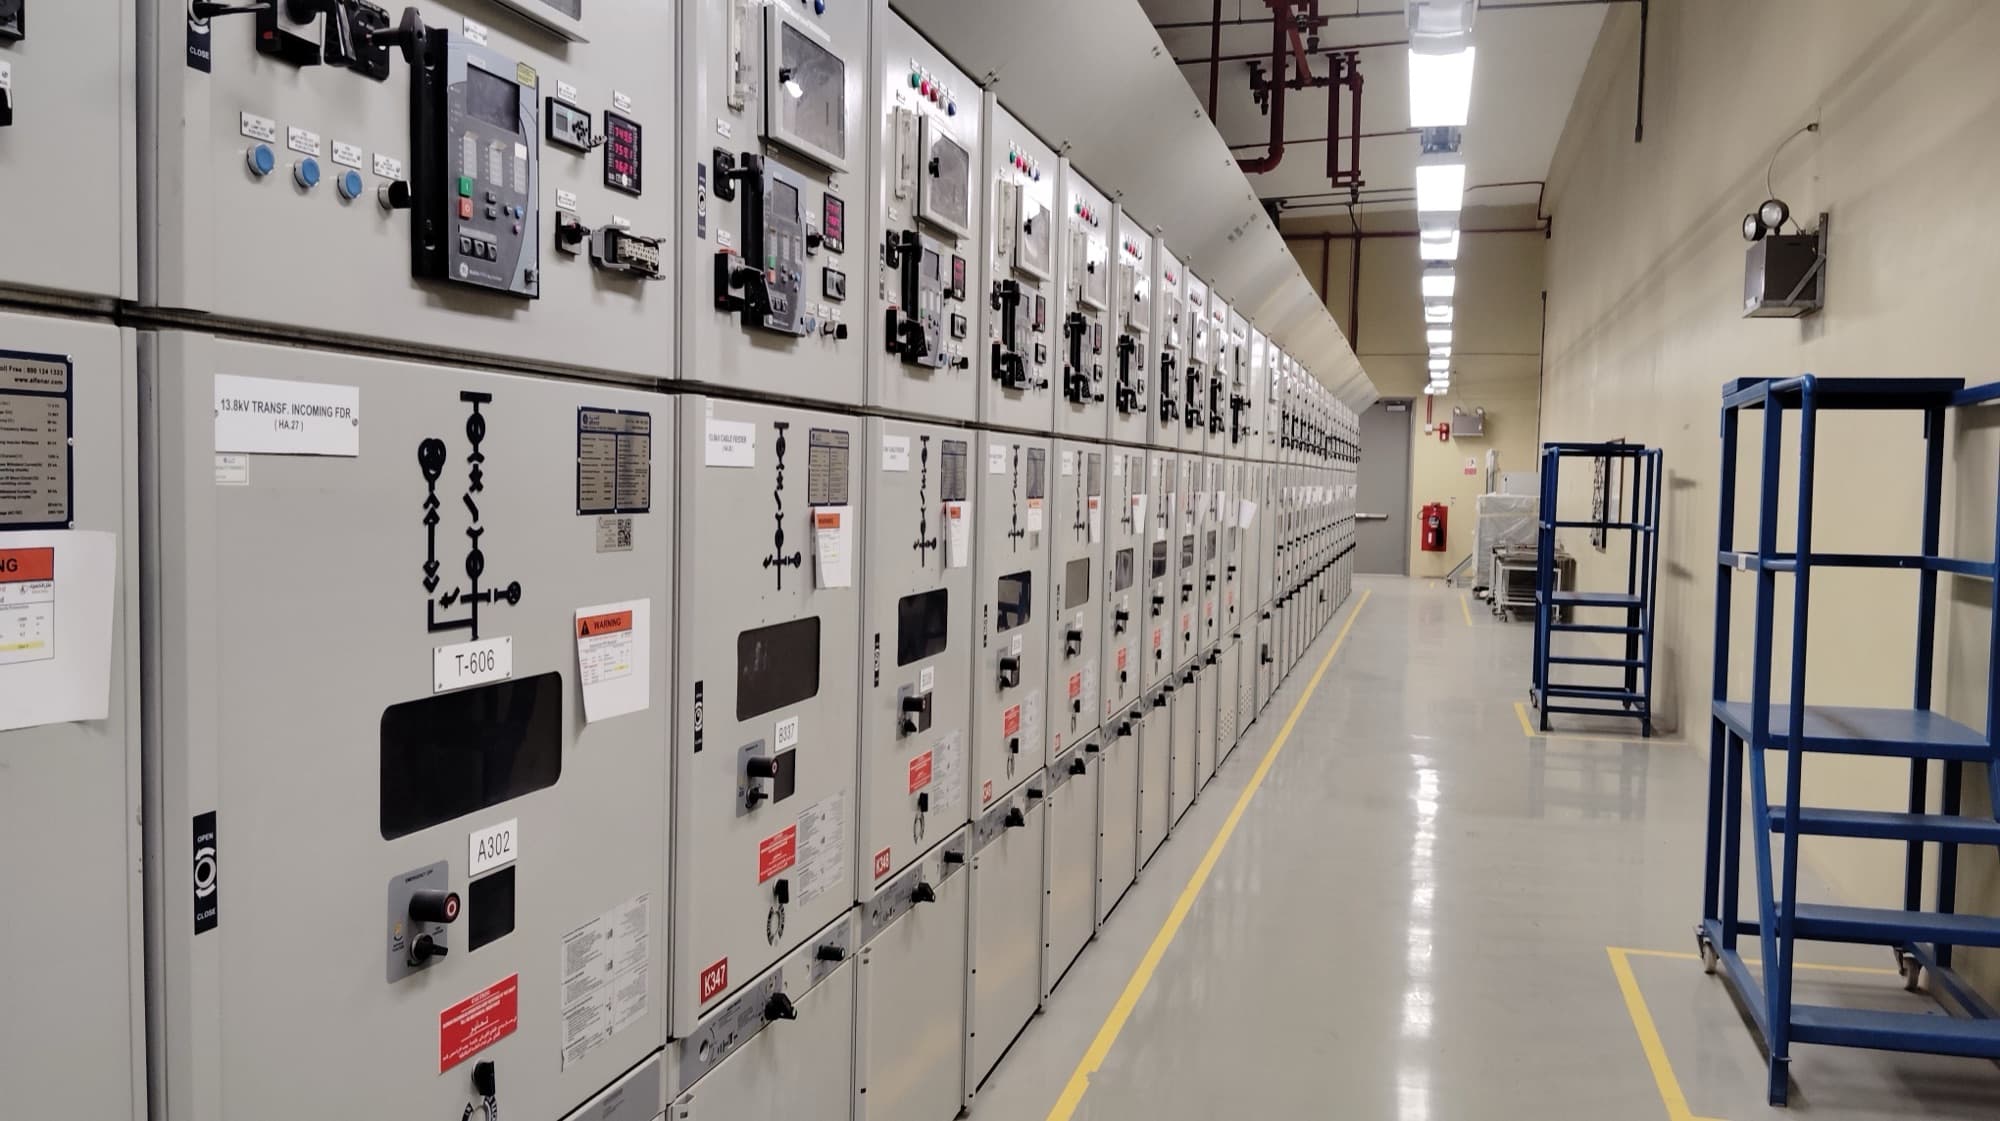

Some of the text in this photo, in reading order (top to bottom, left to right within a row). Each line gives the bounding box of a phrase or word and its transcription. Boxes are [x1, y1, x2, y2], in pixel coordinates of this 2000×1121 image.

[189, 45, 209, 60] CLOSE
[220, 398, 351, 419] 13.8kV TRANSF. INCOMING FDR
[594, 618, 622, 630] WARNING
[455, 649, 495, 677] T-606
[197, 832, 214, 843] OPEN
[477, 830, 511, 864] A302
[197, 907, 216, 921] CLOSE
[704, 964, 726, 997] K347
